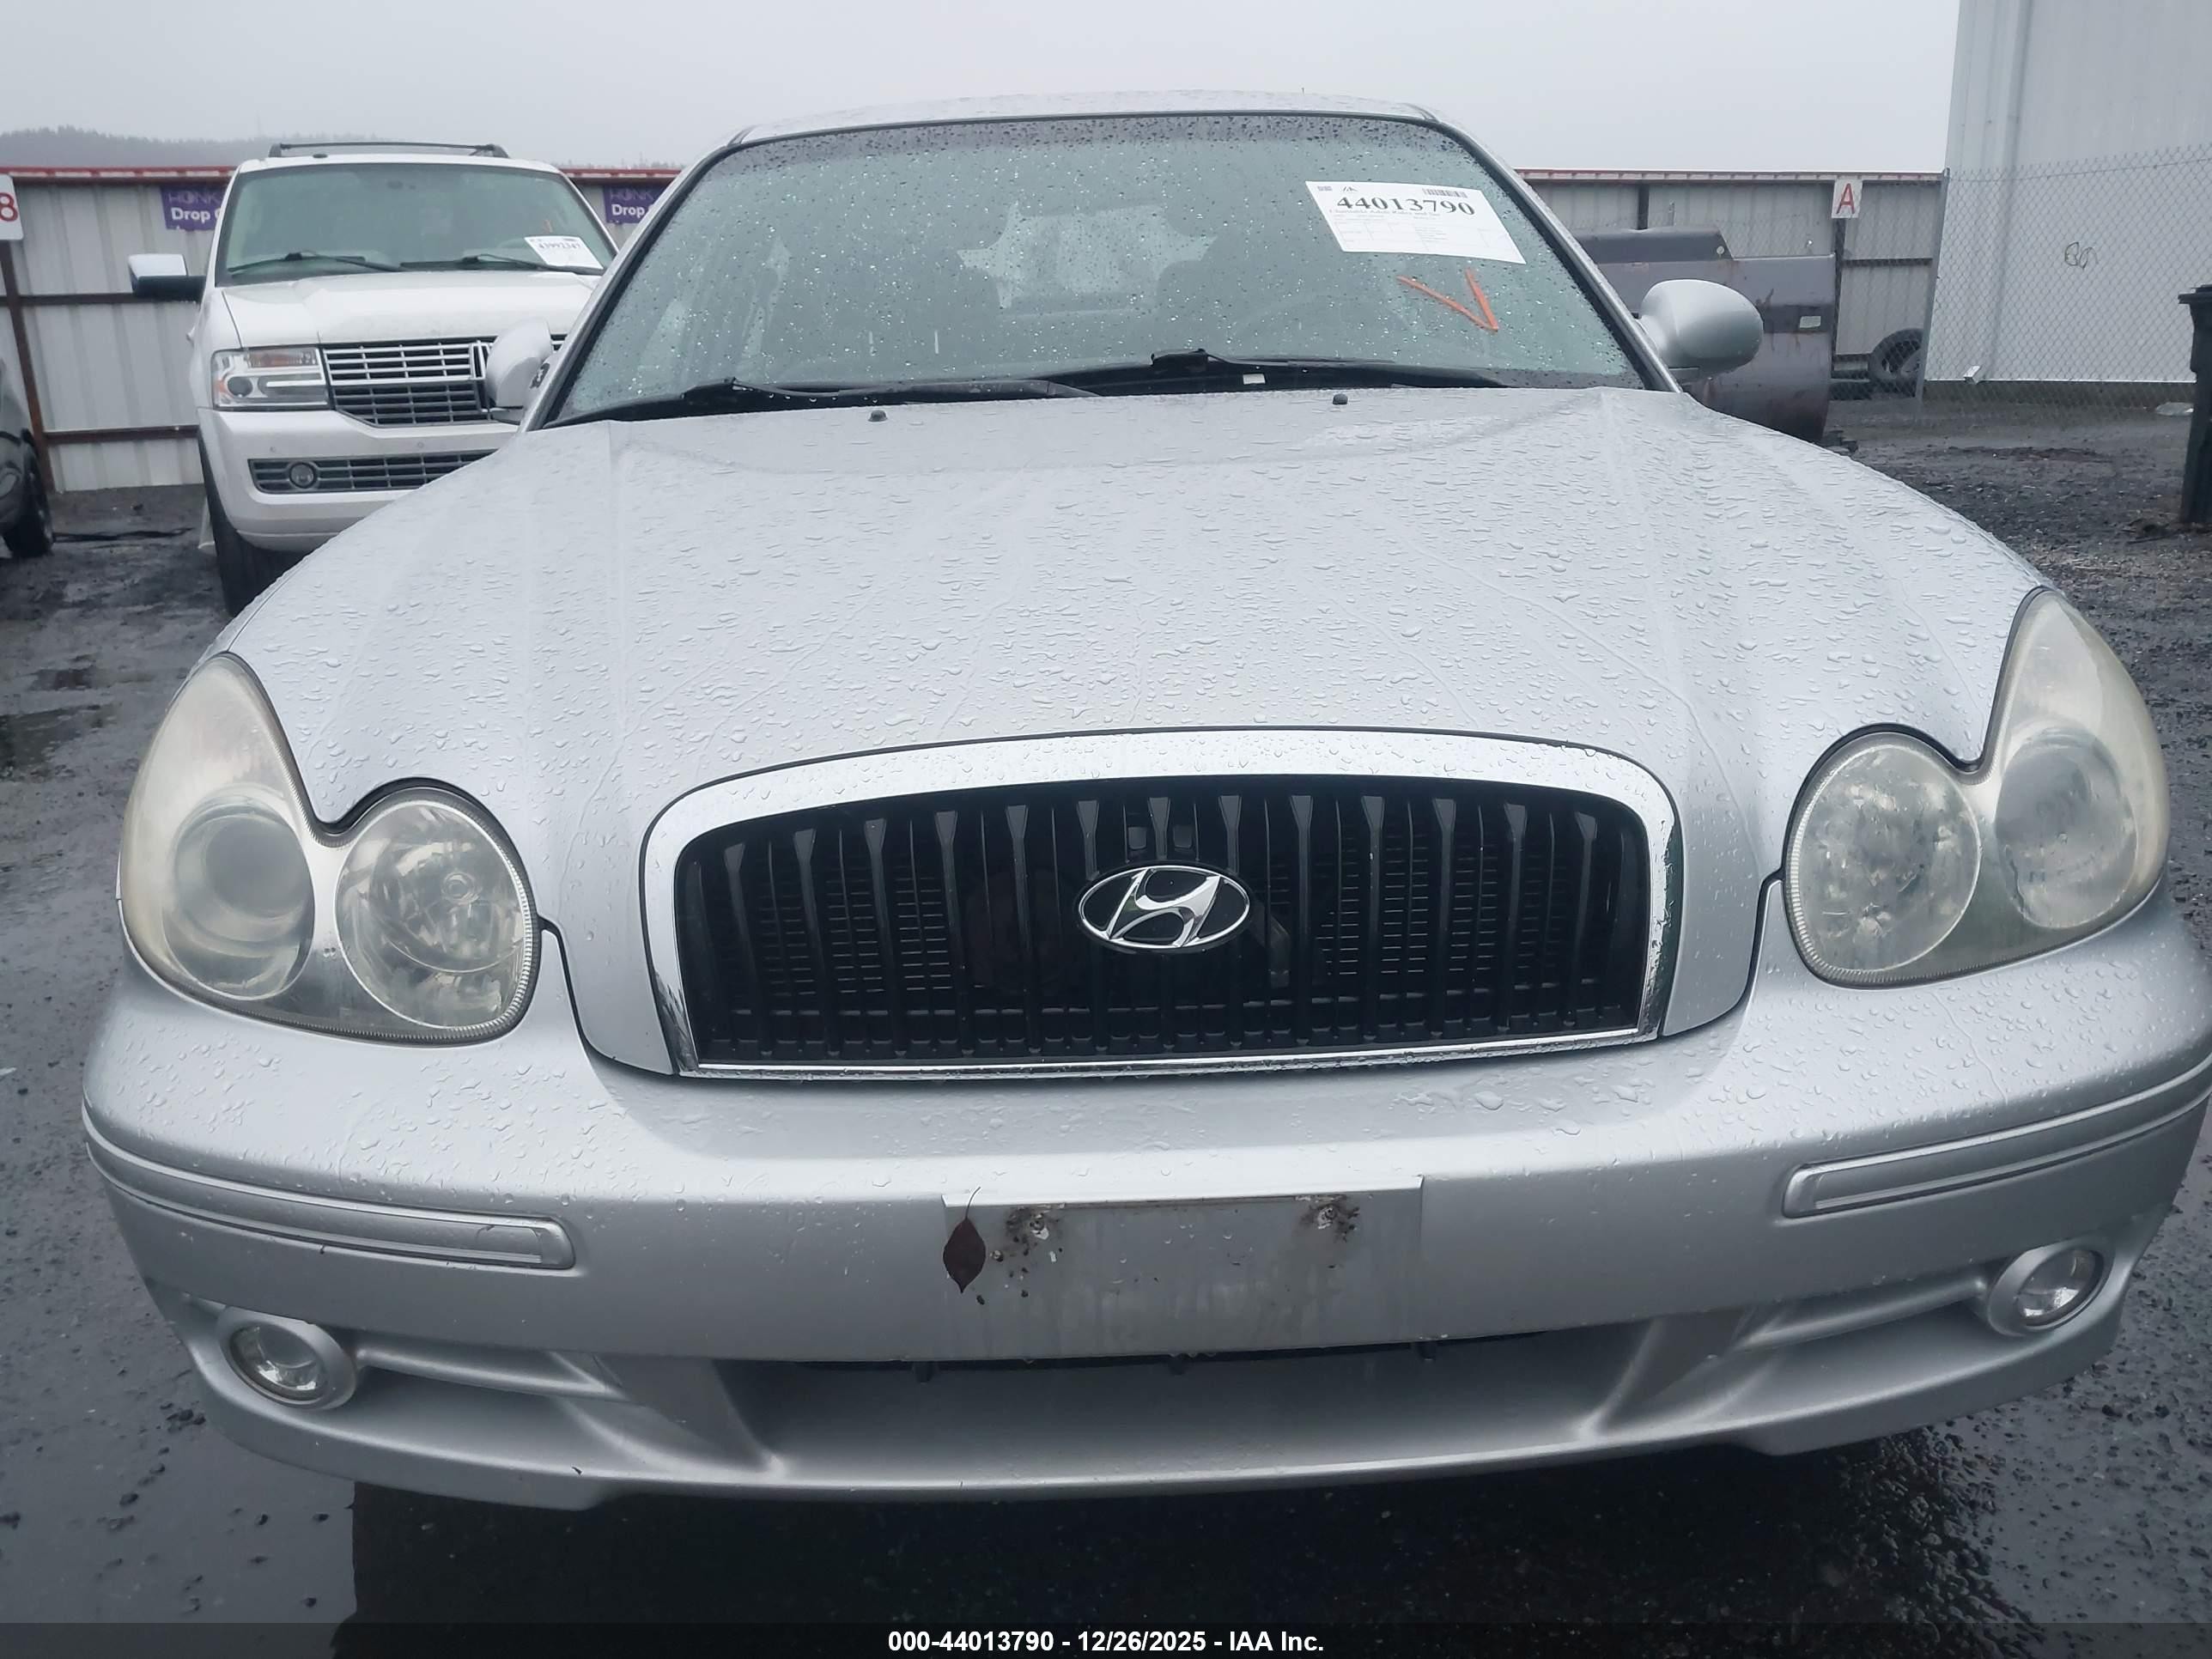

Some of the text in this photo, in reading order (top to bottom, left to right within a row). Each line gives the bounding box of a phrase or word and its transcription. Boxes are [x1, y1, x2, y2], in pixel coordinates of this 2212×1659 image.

[1337, 196, 1476, 216] 44013790
[1835, 182, 1856, 215] A
[170, 207, 211, 224] Drop
[611, 204, 646, 219] Drop
